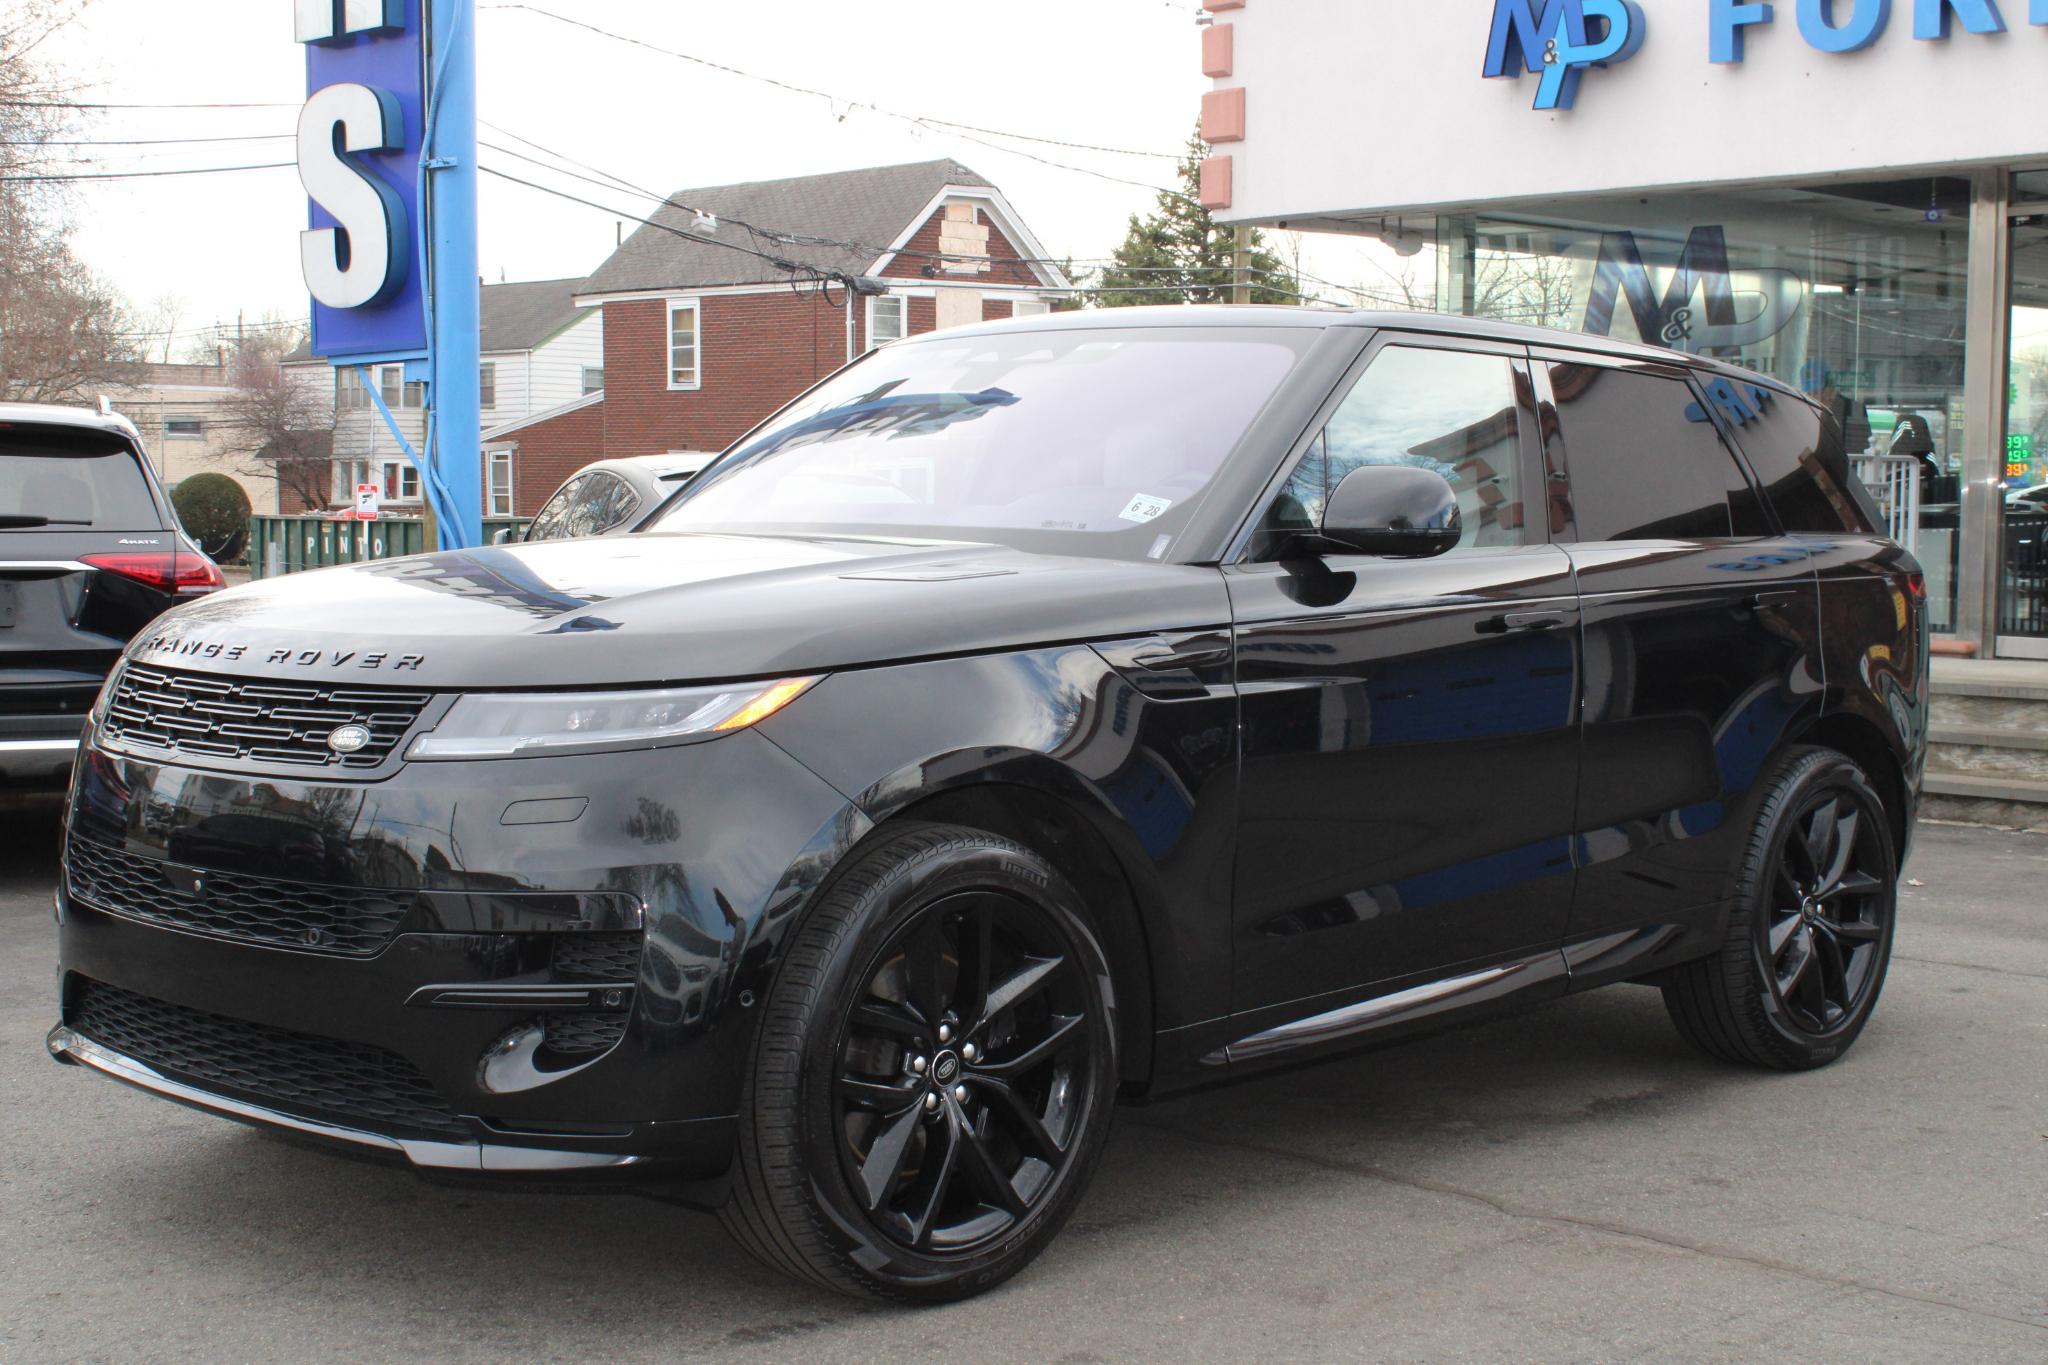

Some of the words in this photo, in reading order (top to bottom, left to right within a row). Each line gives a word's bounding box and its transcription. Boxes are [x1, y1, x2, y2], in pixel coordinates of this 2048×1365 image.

[1131, 502, 1142, 512] 6
[307, 536, 383, 556] PINTO
[148, 637, 248, 661] RANGE
[266, 647, 425, 671] ROVER
